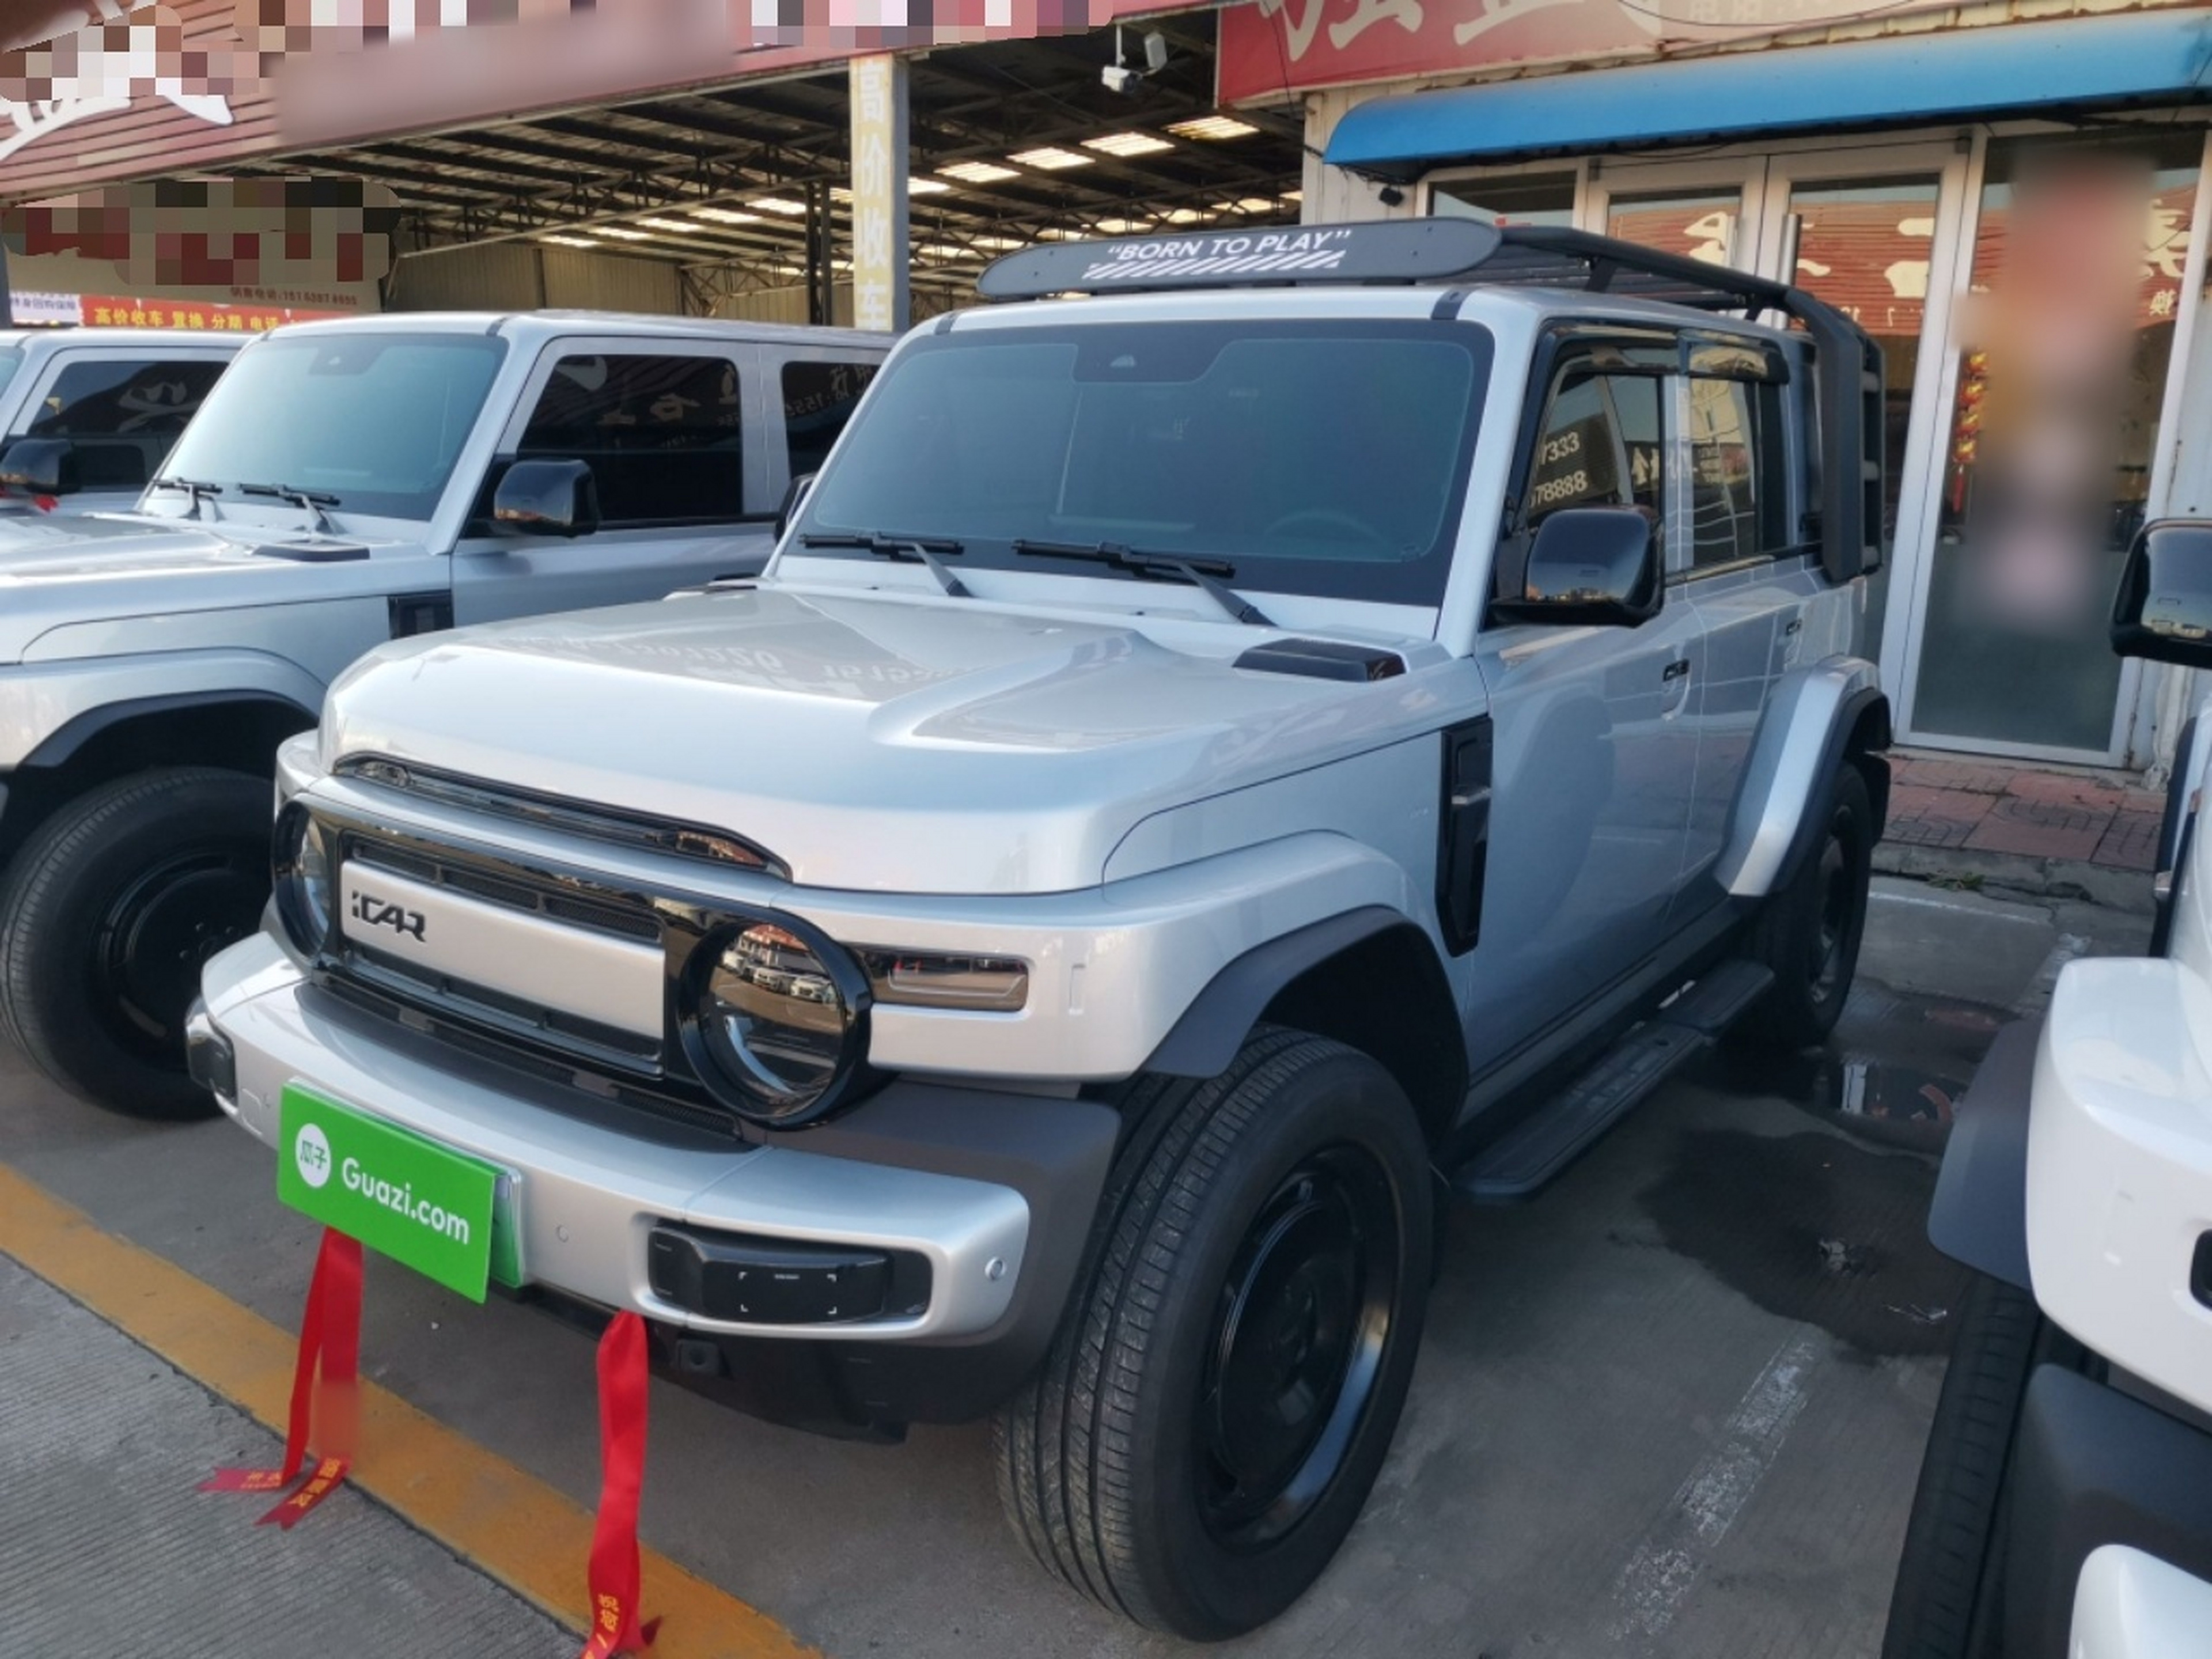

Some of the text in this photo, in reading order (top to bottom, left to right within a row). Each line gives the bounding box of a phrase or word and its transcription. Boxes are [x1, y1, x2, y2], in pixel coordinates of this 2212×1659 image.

[1210, 237, 1251, 255] TO
[94, 306, 164, 327] 高价收车
[172, 310, 204, 329] 置换
[211, 312, 243, 330] 分期
[351, 889, 426, 942] iCAR
[299, 1139, 328, 1170] 瓜子
[342, 1157, 470, 1245] Guazi.com
